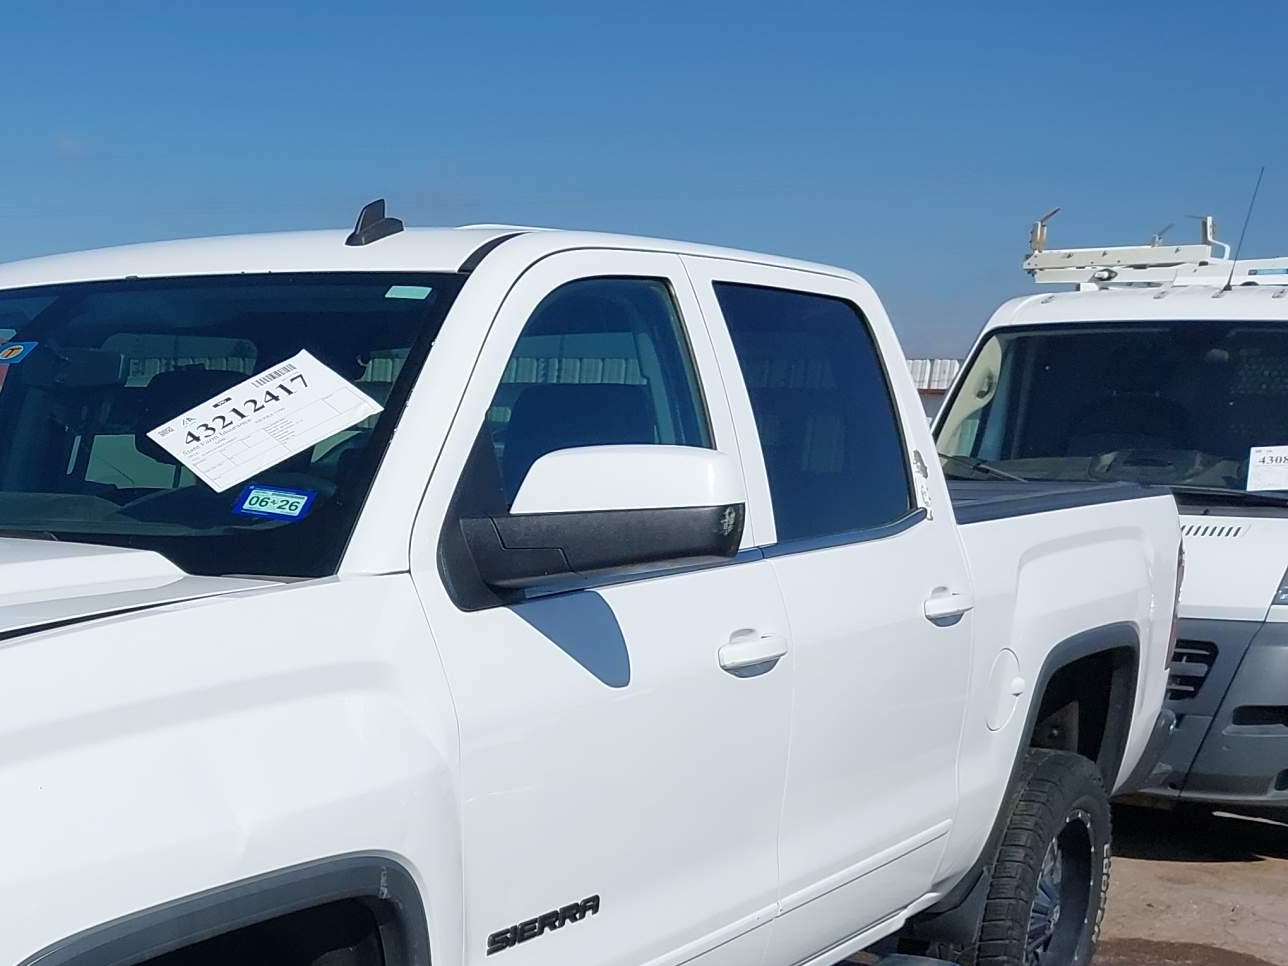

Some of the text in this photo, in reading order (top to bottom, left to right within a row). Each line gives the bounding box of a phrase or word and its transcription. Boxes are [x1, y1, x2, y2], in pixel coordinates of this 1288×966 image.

[185, 374, 309, 445] 43212417
[248, 496, 301, 512] 06 26
[486, 894, 601, 957] SIERRA
